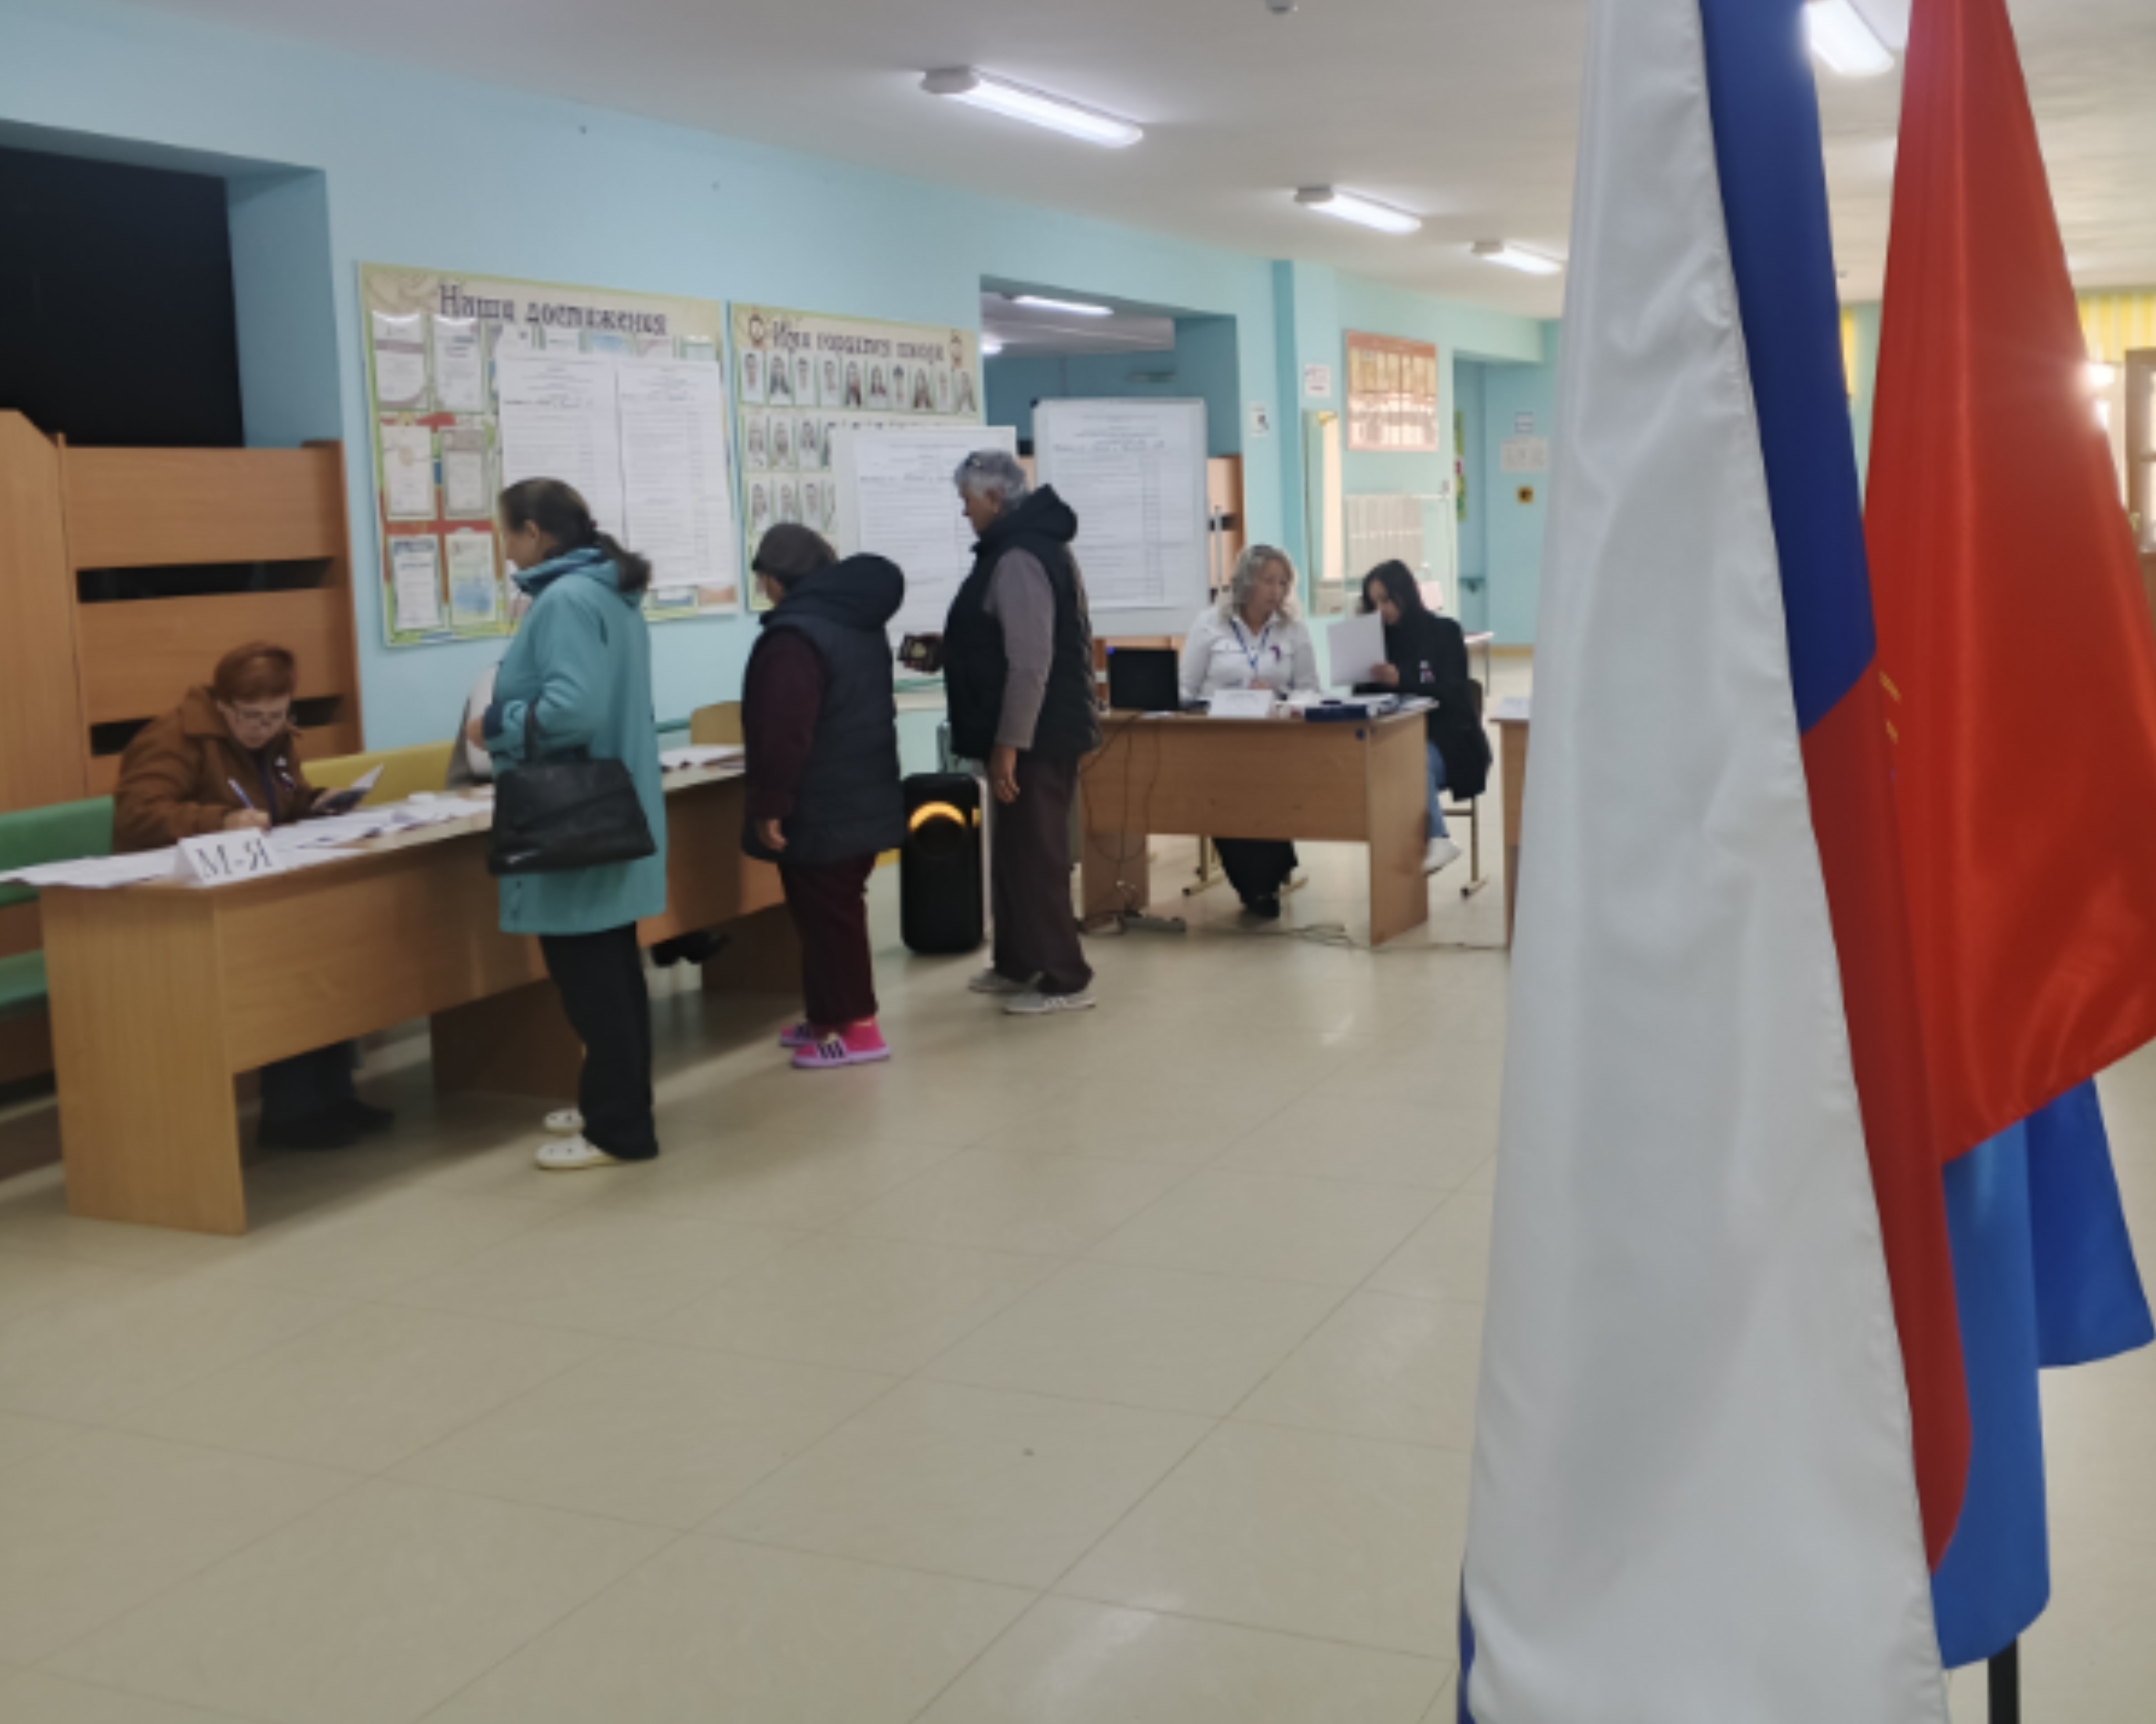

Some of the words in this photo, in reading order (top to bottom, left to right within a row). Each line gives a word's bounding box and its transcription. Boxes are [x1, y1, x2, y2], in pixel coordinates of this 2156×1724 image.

[439, 284, 514, 321] Наши
[526, 302, 666, 335] достижения
[195, 837, 272, 877] М-Я
